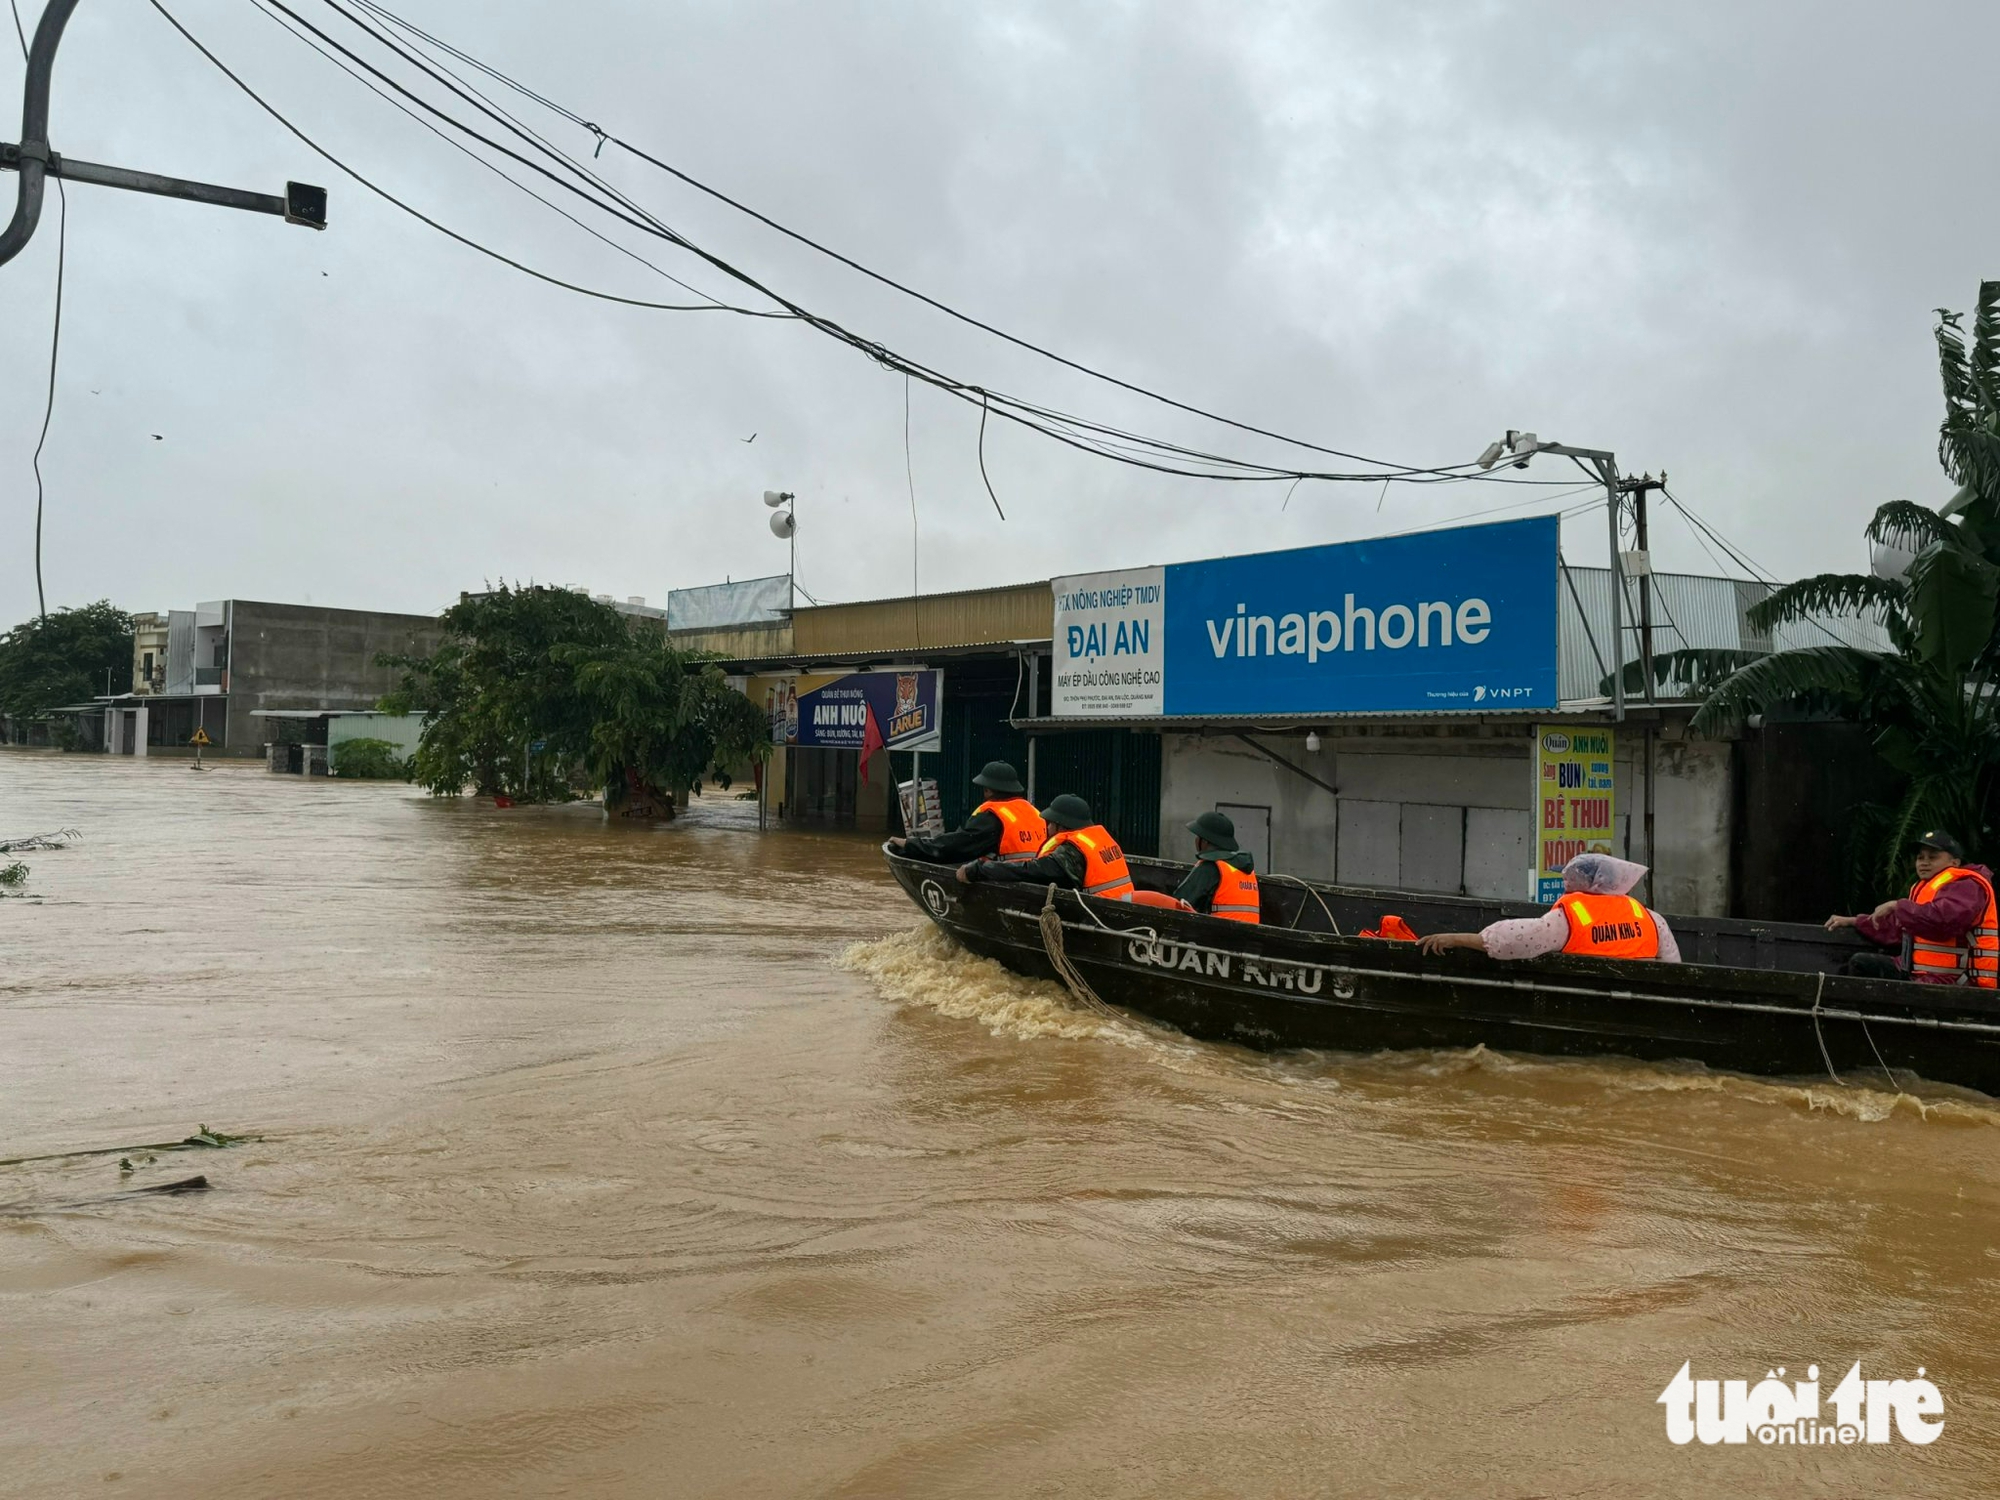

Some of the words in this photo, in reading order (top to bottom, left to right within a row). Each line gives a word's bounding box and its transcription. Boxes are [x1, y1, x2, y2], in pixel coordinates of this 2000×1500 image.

[1072, 588, 1098, 610] NÔNG
[1100, 584, 1133, 609] NGHIỆP
[1135, 585, 1160, 605] TMDV
[1067, 622, 1106, 664] ĐẠI
[1113, 619, 1149, 656] AN
[1206, 594, 1491, 663] vinaphone
[1058, 671, 1071, 687] MÁY
[1073, 670, 1081, 686] ÉP
[1083, 668, 1098, 687] DẦU
[1099, 669, 1120, 686] CÔNG
[1121, 668, 1142, 687] NGHỆ
[1144, 671, 1160, 685] CAO
[1490, 687, 1533, 698] VNPT
[813, 705, 838, 725] ANH
[841, 699, 867, 726] NUÔ
[890, 710, 922, 736] LARUE
[1545, 735, 1567, 750] Quán
[1573, 735, 1589, 753] ANH
[1559, 759, 1580, 788] BÚN
[1544, 794, 1565, 828] BÊ
[1570, 799, 1609, 828] THUI
[1592, 922, 1617, 944] QUÂN
[1618, 923, 1635, 940] KHU
[1634, 921, 1642, 938] 5
